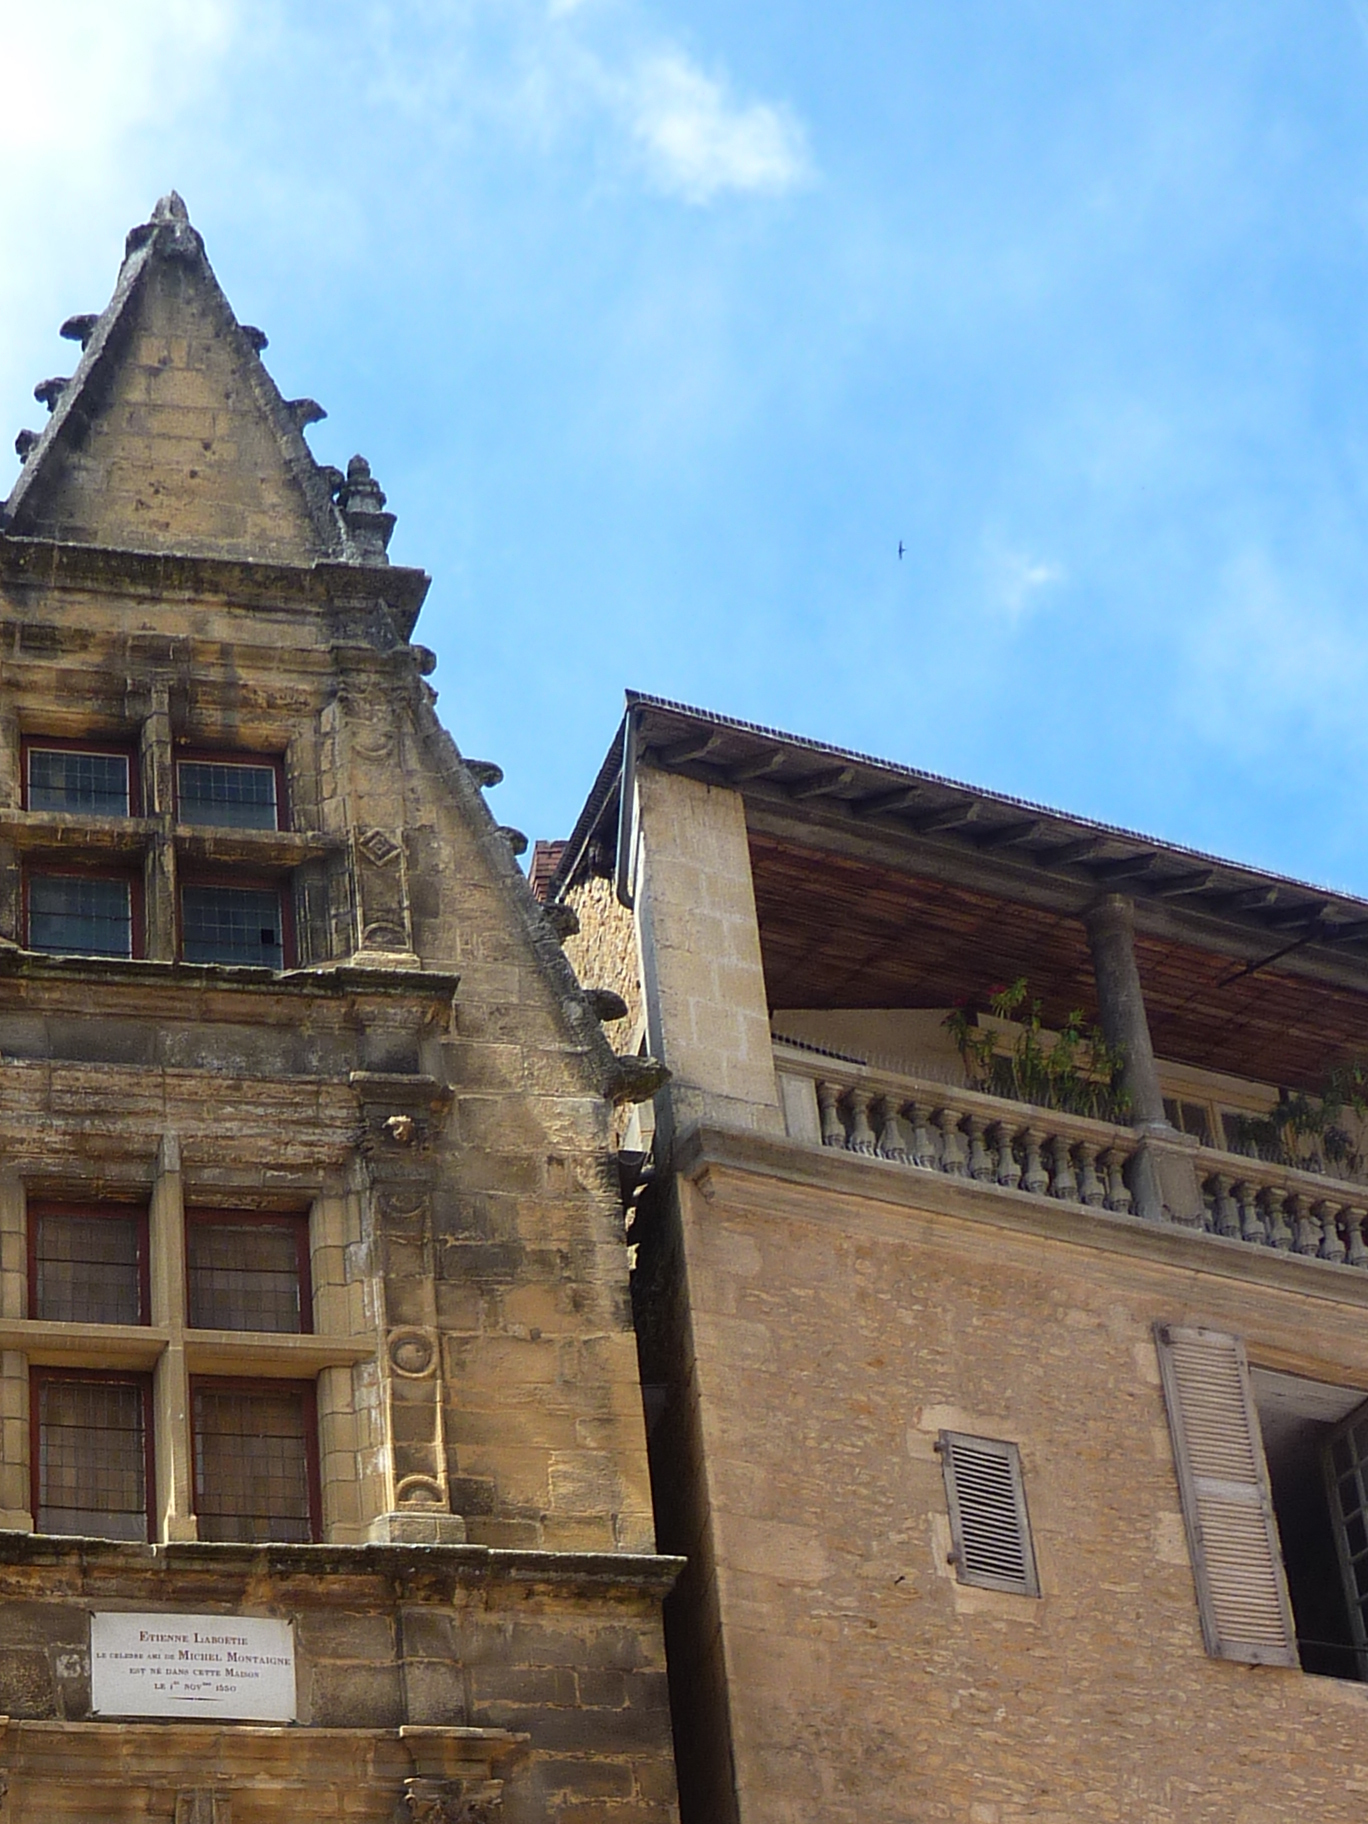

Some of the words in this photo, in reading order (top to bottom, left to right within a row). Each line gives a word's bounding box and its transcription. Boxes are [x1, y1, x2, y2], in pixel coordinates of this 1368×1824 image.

[178, 1649, 222, 1662] MICHEL
[227, 1651, 292, 1666] MONTAIGNE
[129, 1667, 146, 1675] EST
[165, 1668, 189, 1676] DANS
[193, 1668, 221, 1677] CETTE
[225, 1668, 260, 1678] MAISON
